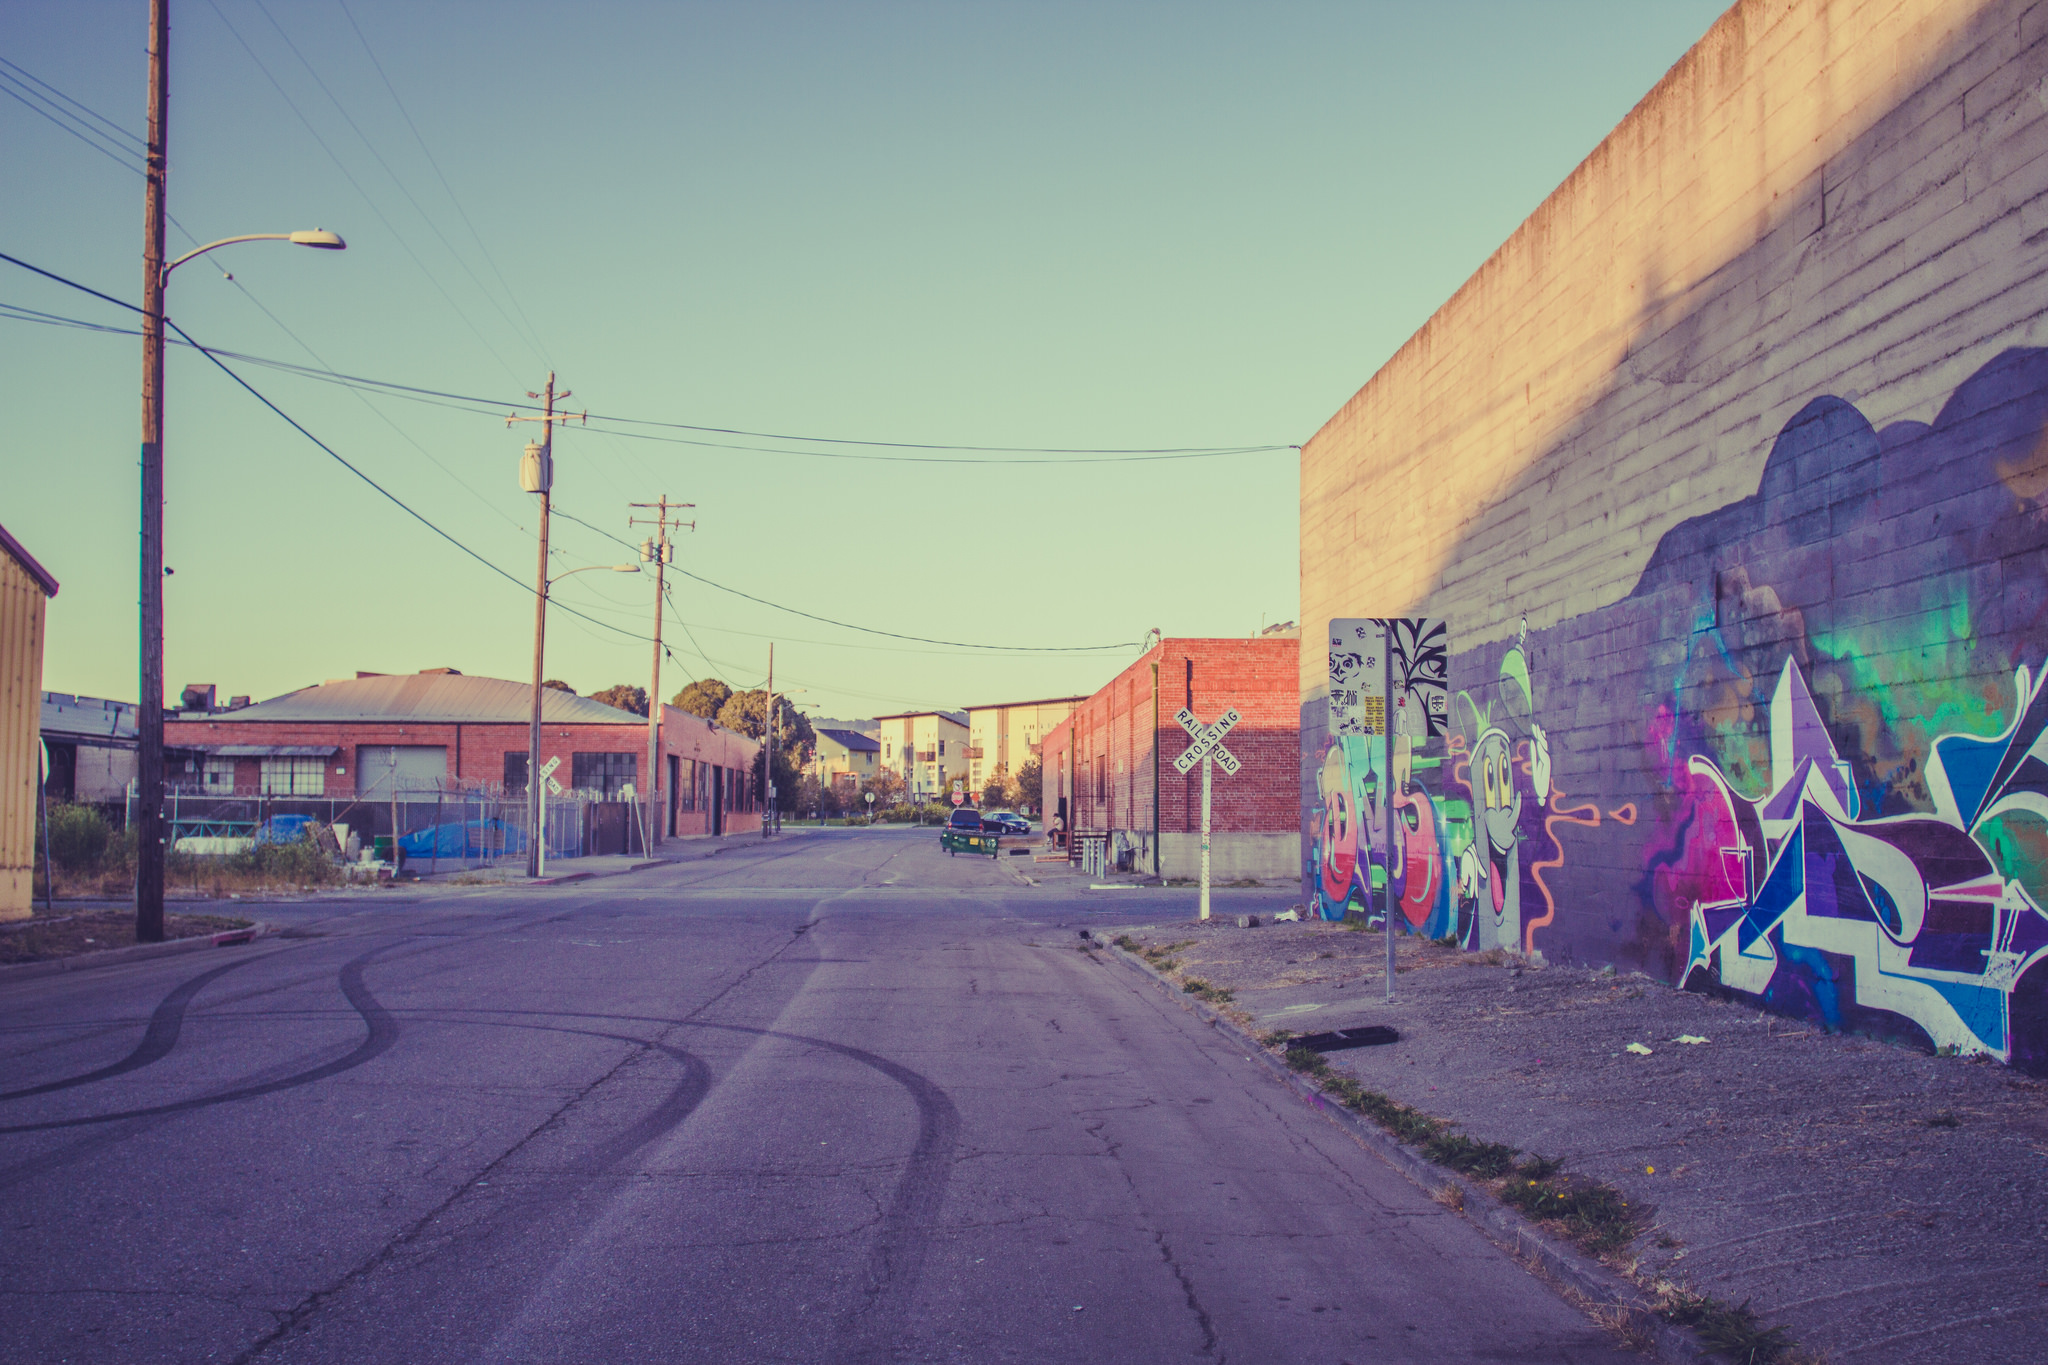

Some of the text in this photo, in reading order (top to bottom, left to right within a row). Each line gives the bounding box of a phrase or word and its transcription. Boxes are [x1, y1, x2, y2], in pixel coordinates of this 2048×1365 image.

[1177, 710, 1202, 739] RAIL
[1211, 743, 1237, 771] ROAD
[1178, 711, 1238, 769] CROSSING
